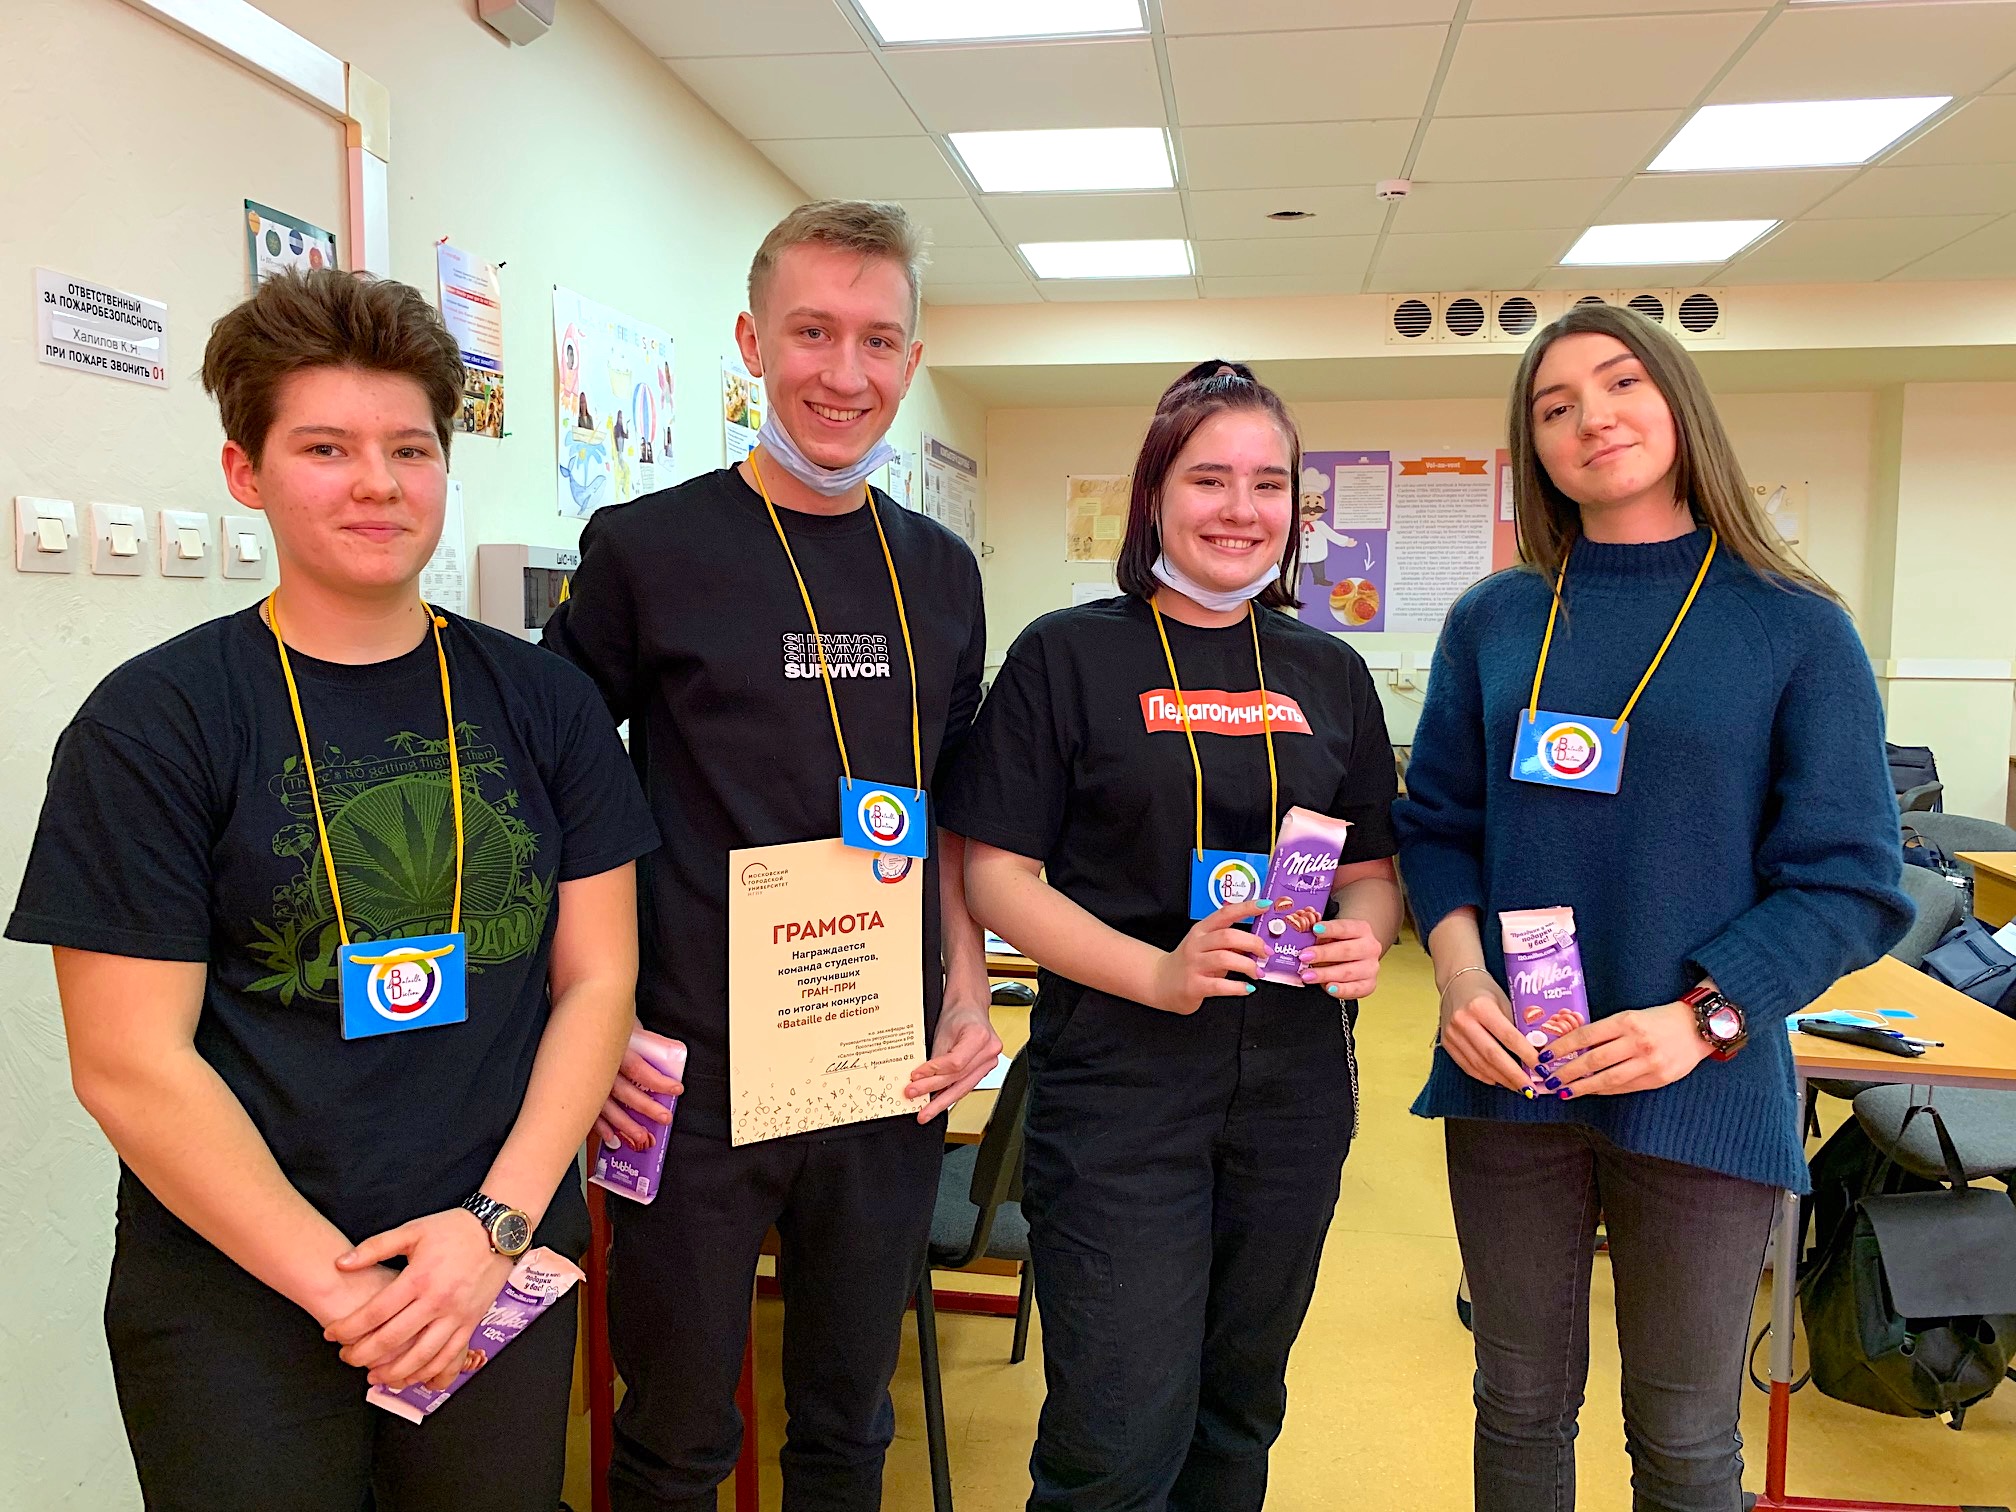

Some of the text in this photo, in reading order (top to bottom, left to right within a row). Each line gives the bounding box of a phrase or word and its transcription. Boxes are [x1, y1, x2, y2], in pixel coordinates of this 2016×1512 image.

[68, 283, 141, 313] ОТВЕТСТВЕННЫЙ
[44, 291, 163, 333] ЗА ПОЖАРОБЕЗОПАСНОСТЬ
[73, 328, 118, 350] Халилов
[46, 345, 164, 381] ПРИ ПОЖАРЕ ЗВОНИТЬ 01
[784, 662, 891, 678] SURVIVOR
[344, 767, 365, 780] NO
[369, 760, 418, 779] getting
[466, 749, 493, 762] than
[1283, 851, 1338, 875] Milka
[749, 869, 788, 878] МОСКОВСКИЙ
[749, 876, 783, 884] ГОРОДСКОЙ
[748, 882, 788, 891] УНИВЕРСИТЕТ
[774, 911, 884, 944] ГРАМОТА
[1522, 929, 1552, 942] подарки
[1534, 935, 1549, 944] вас!
[792, 942, 866, 960] Награждается
[778, 962, 822, 976] команда
[798, 970, 860, 986] получивших
[1514, 962, 1572, 995] Milka
[802, 982, 856, 998] ГРАН-ПРИ
[1543, 987, 1562, 999] 120
[778, 993, 878, 1016] по итогам конкурса
[777, 1005, 880, 1029] «Bataille de diction»
[611, 1157, 639, 1177] bubbles
[525, 1275, 551, 1284] подарки
[530, 1283, 544, 1291] вас!
[481, 1301, 529, 1328] Milka
